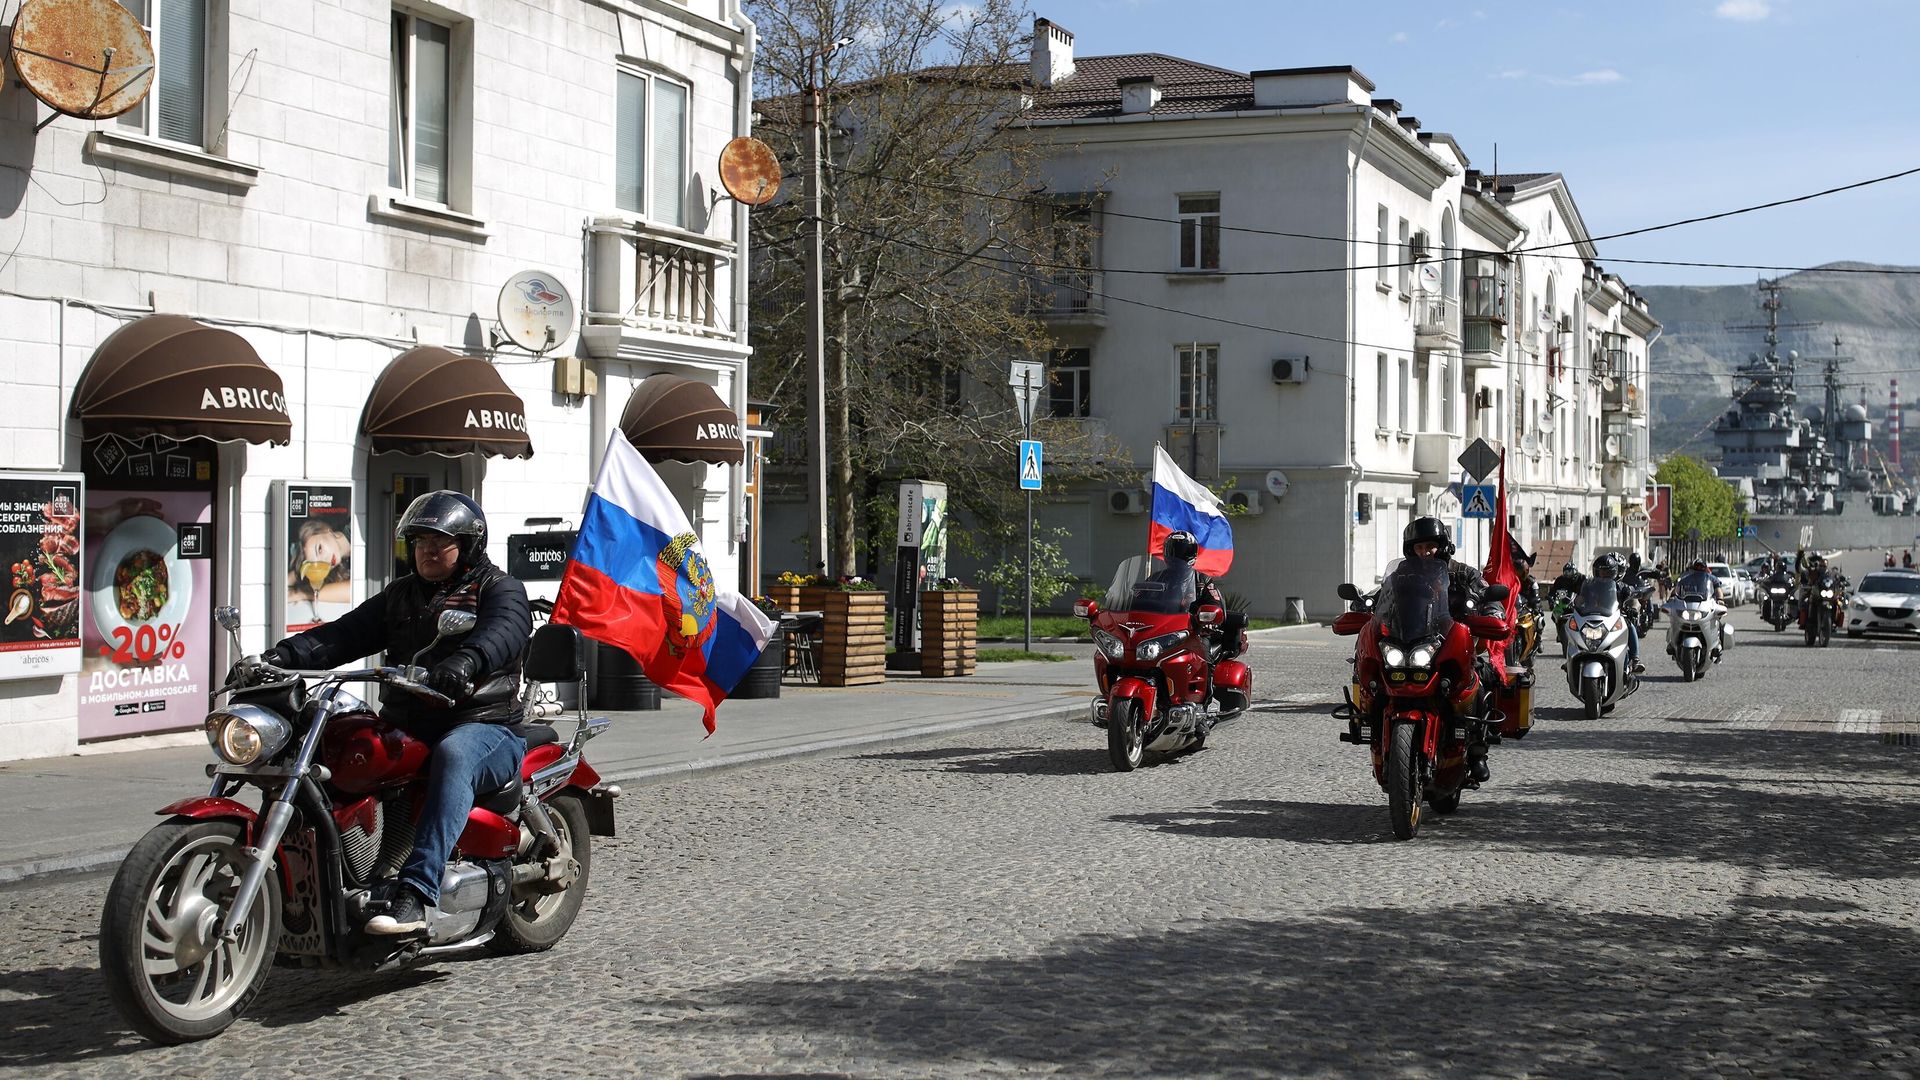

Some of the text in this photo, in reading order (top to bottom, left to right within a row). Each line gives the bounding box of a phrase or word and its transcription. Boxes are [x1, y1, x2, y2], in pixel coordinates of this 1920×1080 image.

[200, 387, 288, 416] ABRICOS
[464, 409, 526, 433] ABRICO
[14, 502, 46, 511] ЗНАЕМ
[1800, 525, 1814, 548] 105
[529, 548, 562, 562] abricos
[99, 623, 185, 663] -20%
[22, 655, 49, 665] abricos
[89, 664, 190, 693] ДОСТАВКА
[81, 696, 87, 704] В
